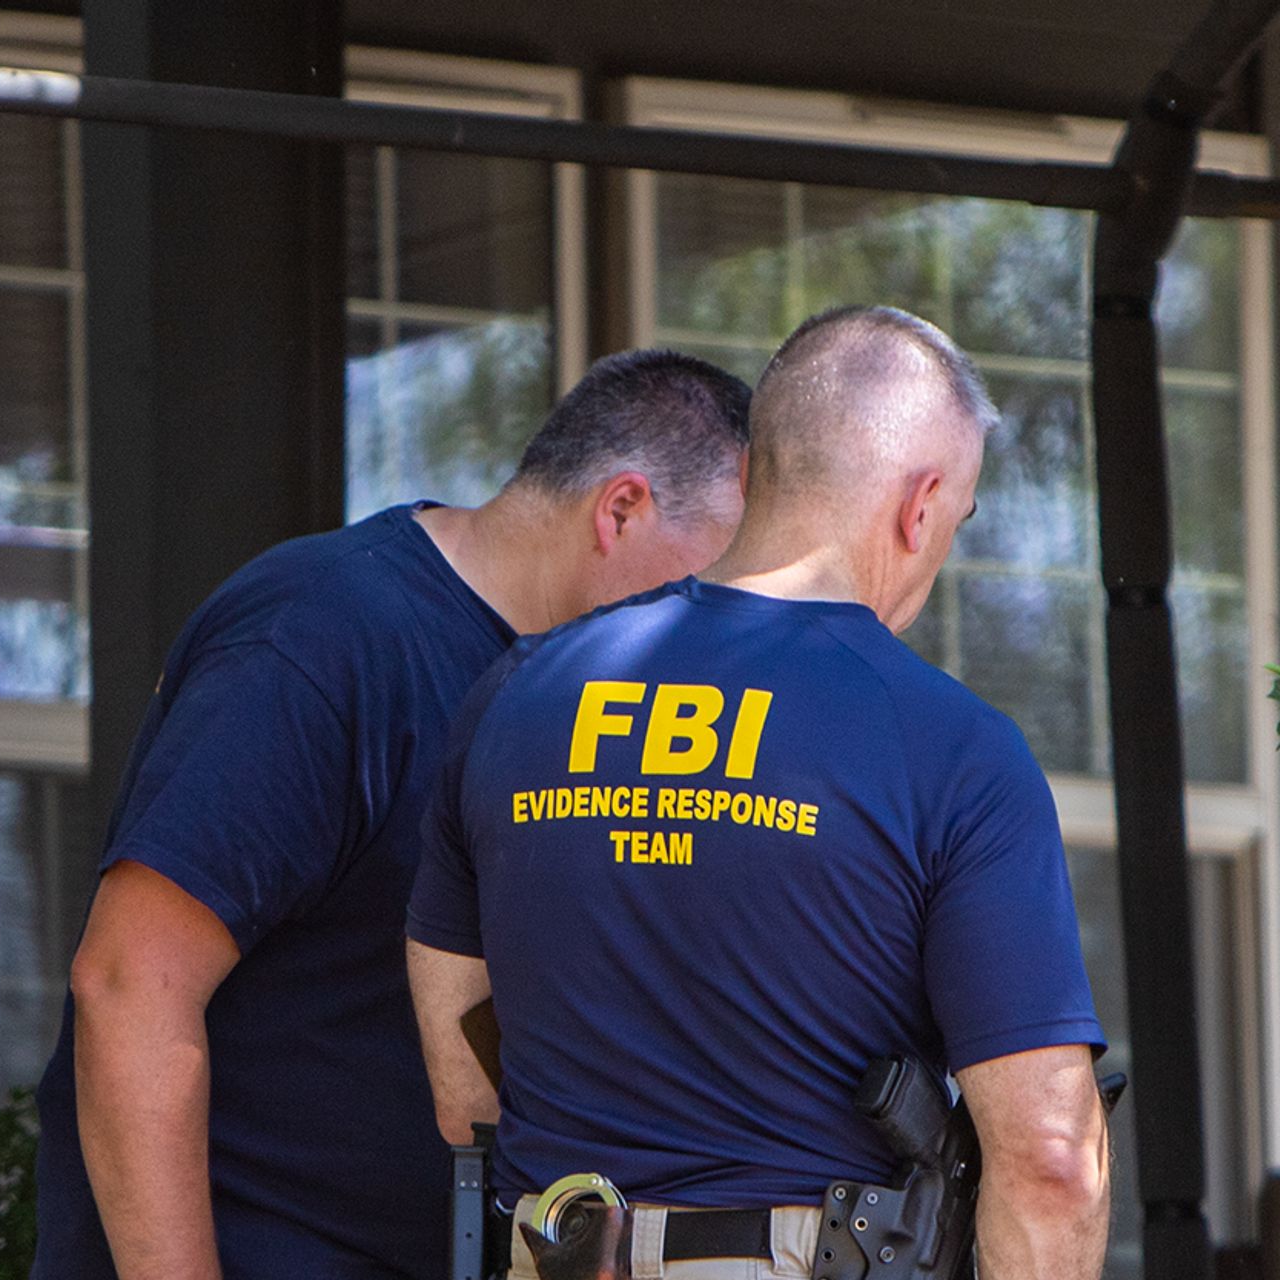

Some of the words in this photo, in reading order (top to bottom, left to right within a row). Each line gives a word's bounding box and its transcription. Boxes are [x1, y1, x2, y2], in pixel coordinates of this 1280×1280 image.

[568, 680, 773, 780] FBI
[512, 786, 650, 824] EVIDENCE
[656, 787, 819, 837] RESPONSE
[609, 830, 694, 866] TEAM
